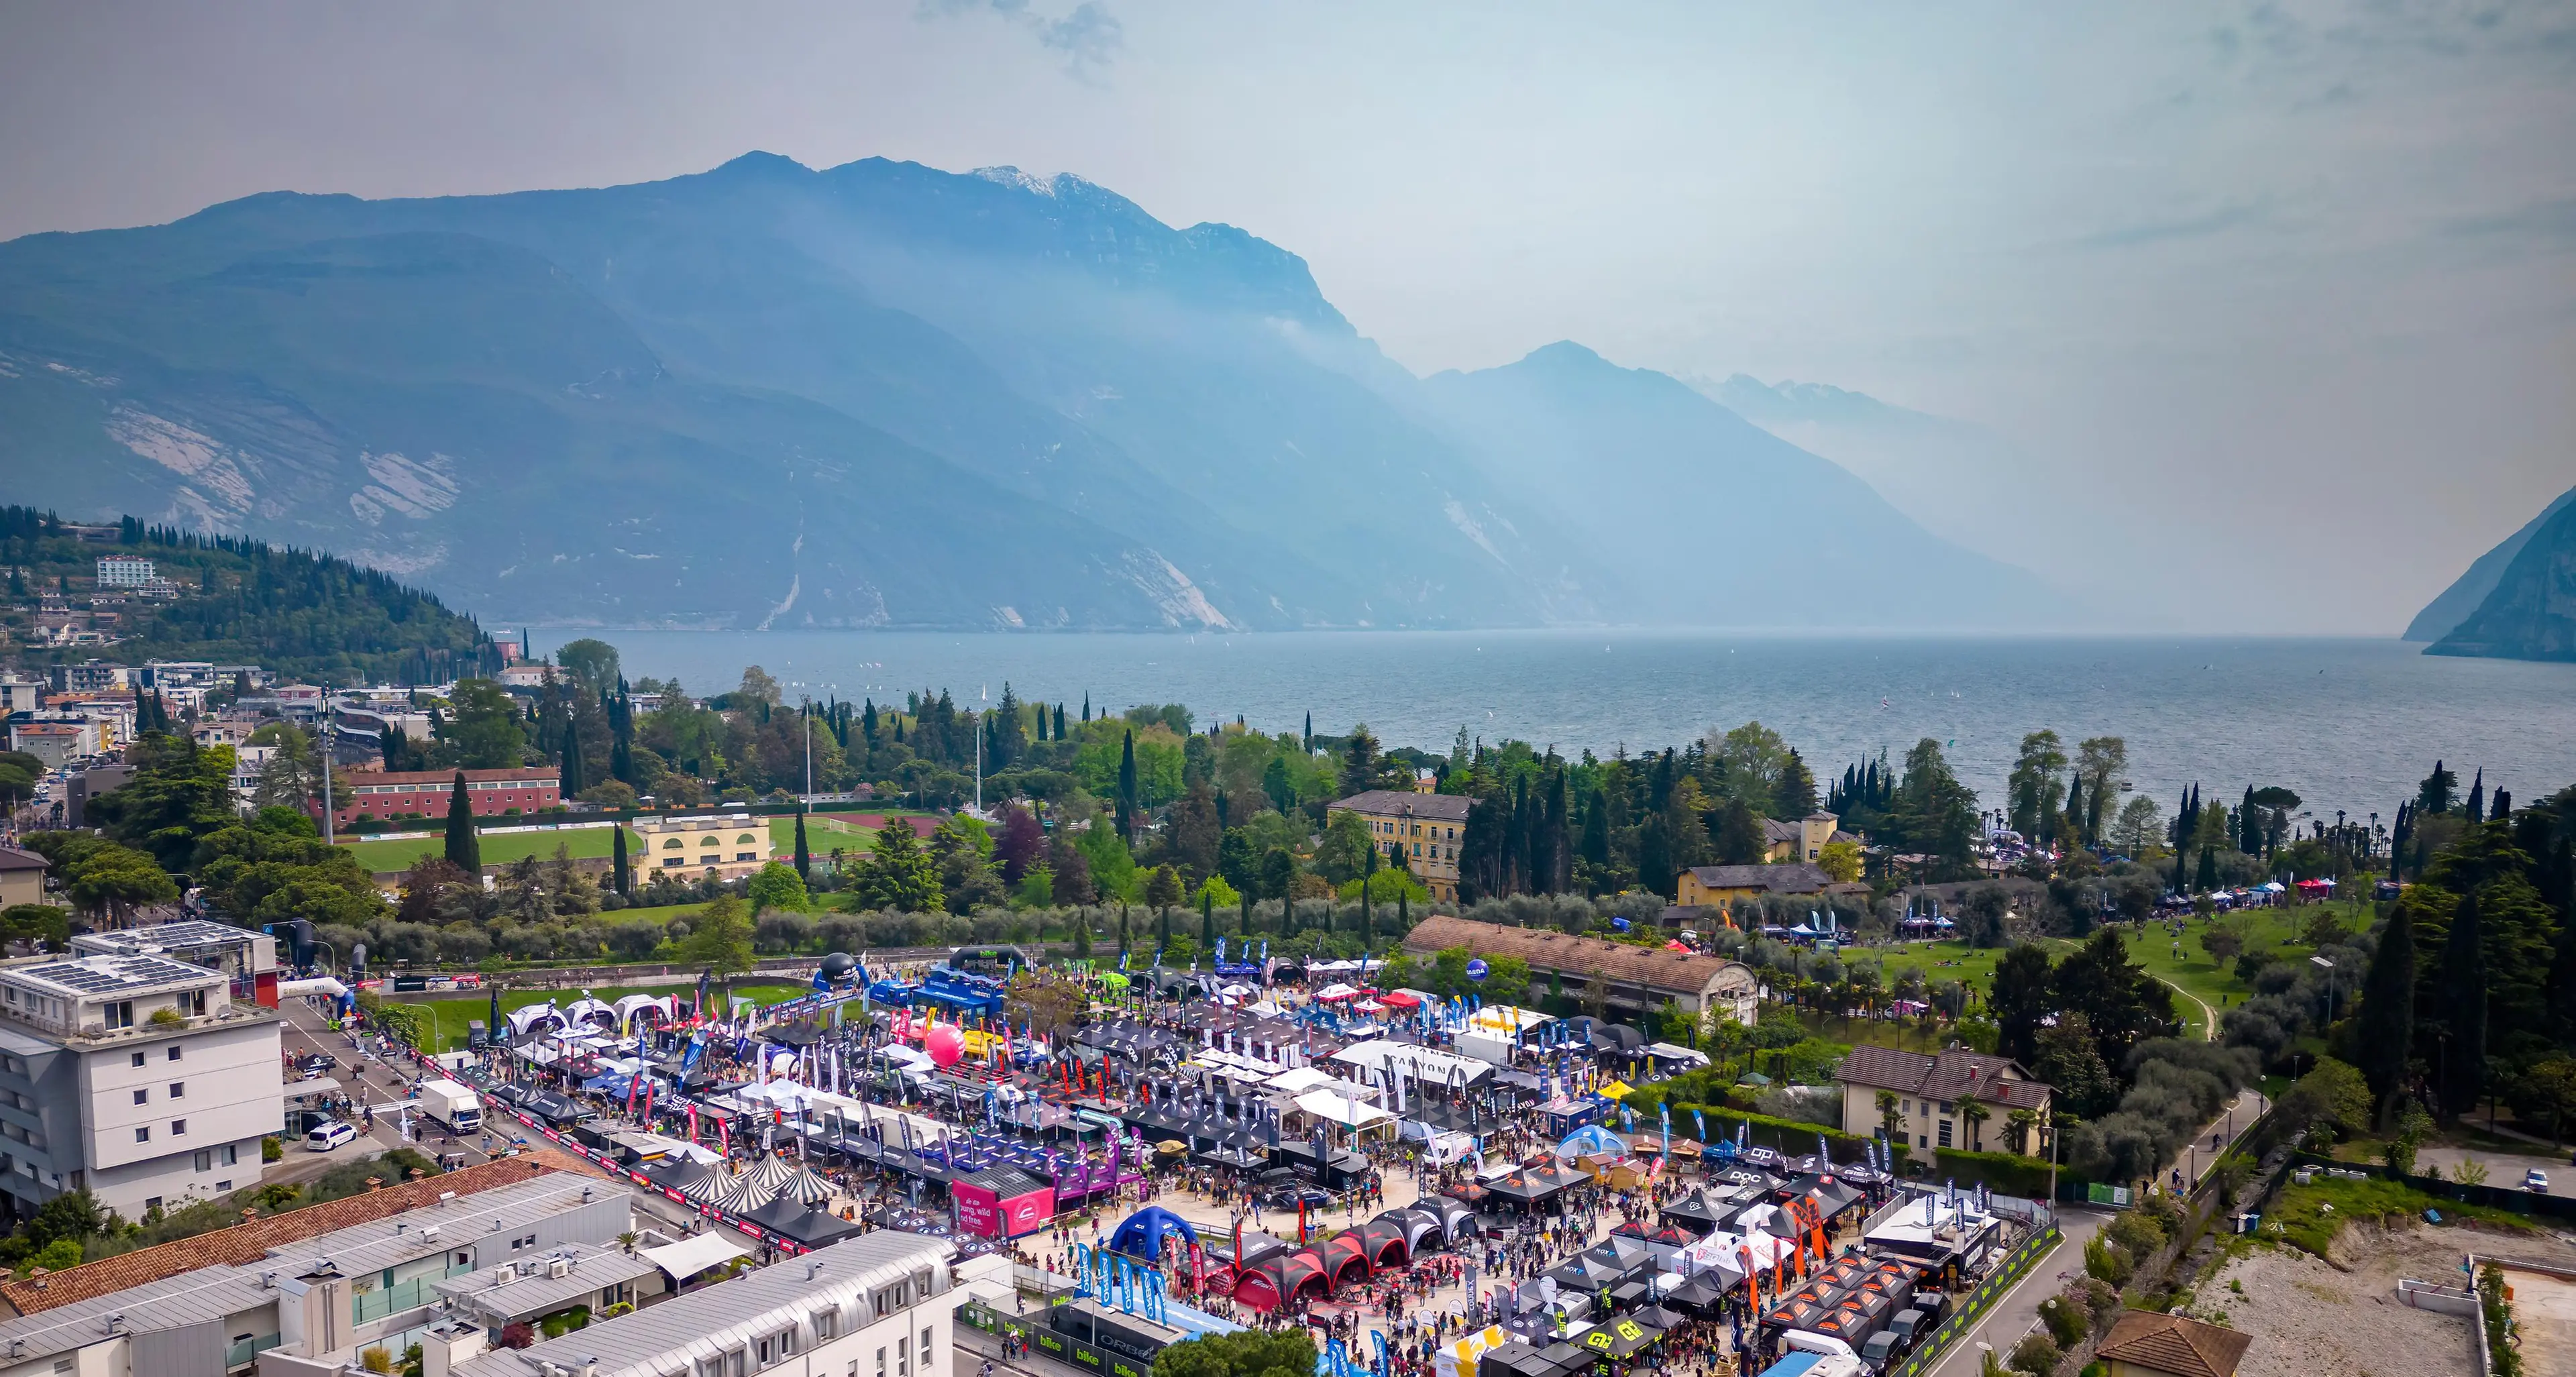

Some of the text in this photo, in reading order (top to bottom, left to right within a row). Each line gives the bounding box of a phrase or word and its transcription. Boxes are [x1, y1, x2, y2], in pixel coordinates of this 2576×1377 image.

[900, 1013, 910, 1034] SWISS
[1844, 1169, 1873, 1177] GIST
[960, 1204, 991, 1216] oung, wild
[1040, 1335, 1062, 1352] bike
[1077, 1348, 1099, 1366] bike
